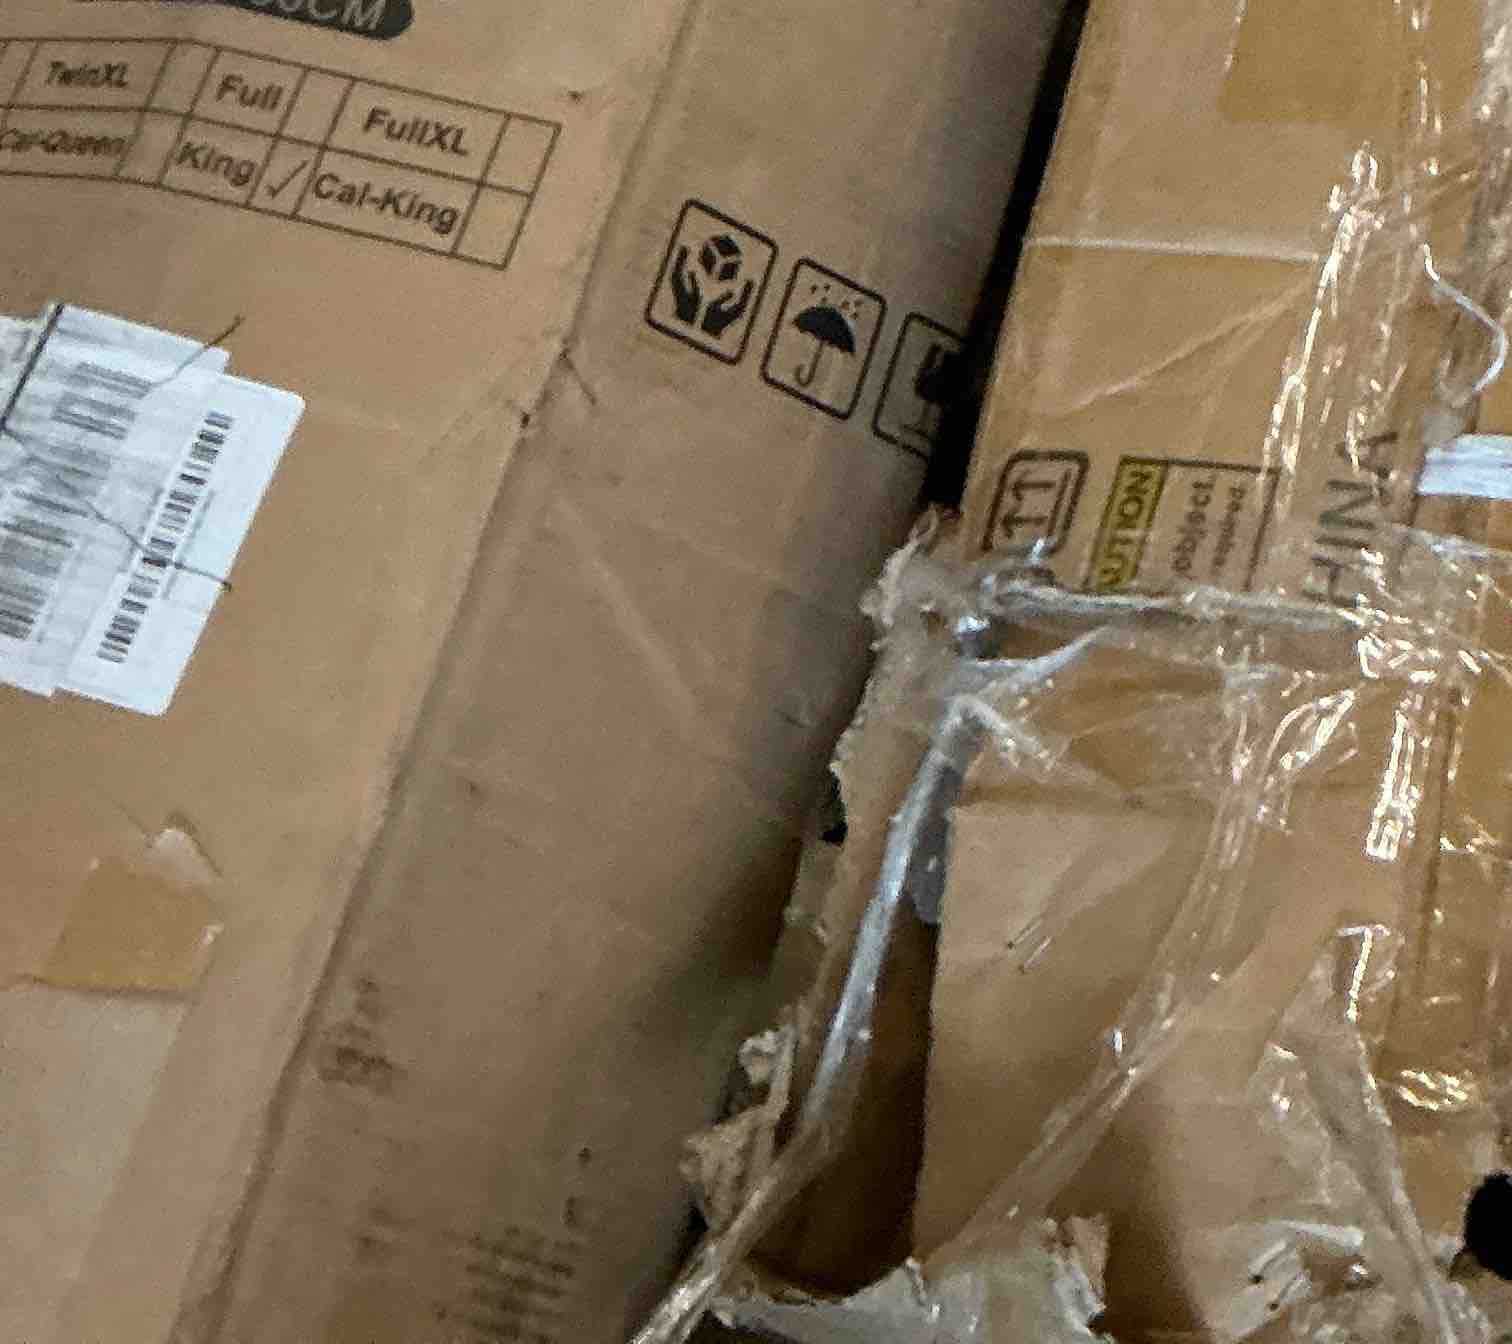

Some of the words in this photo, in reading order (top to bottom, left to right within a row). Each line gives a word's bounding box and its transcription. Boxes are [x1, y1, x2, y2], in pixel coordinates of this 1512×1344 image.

[216, 73, 284, 110] Full
[362, 106, 469, 157] FullXL
[177, 140, 256, 188] King
[313, 172, 459, 238] Cal-King
